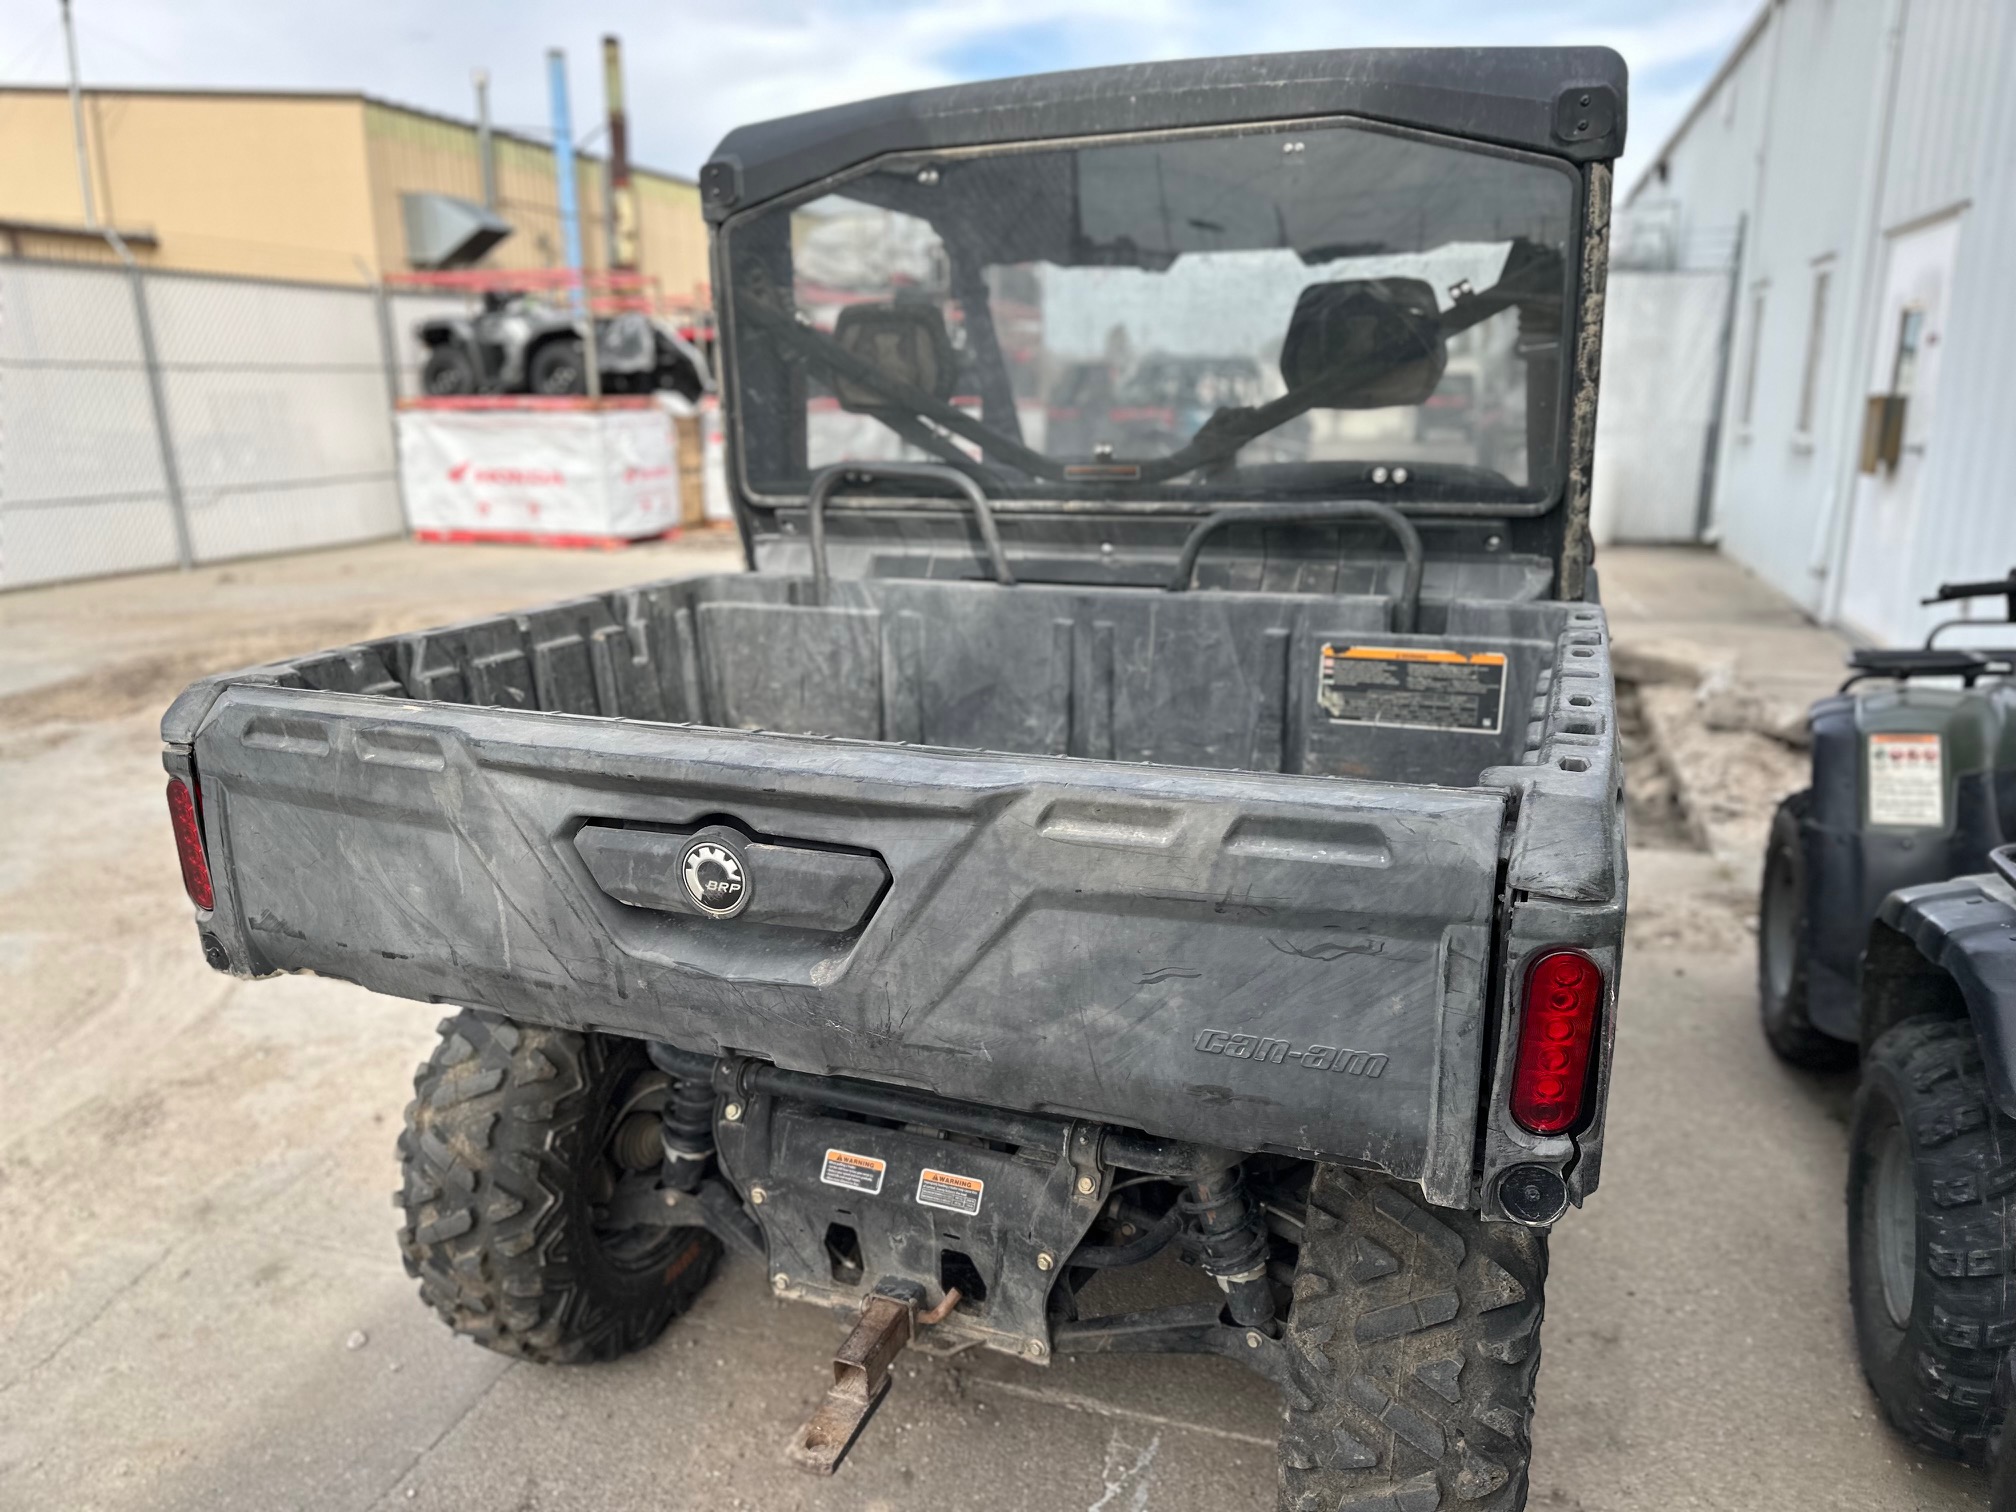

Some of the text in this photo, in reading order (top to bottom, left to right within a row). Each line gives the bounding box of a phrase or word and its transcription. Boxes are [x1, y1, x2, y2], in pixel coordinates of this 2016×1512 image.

[705, 880, 741, 893] BRP
[843, 1156, 875, 1168] WARNING
[939, 1176, 972, 1188] WARNING
